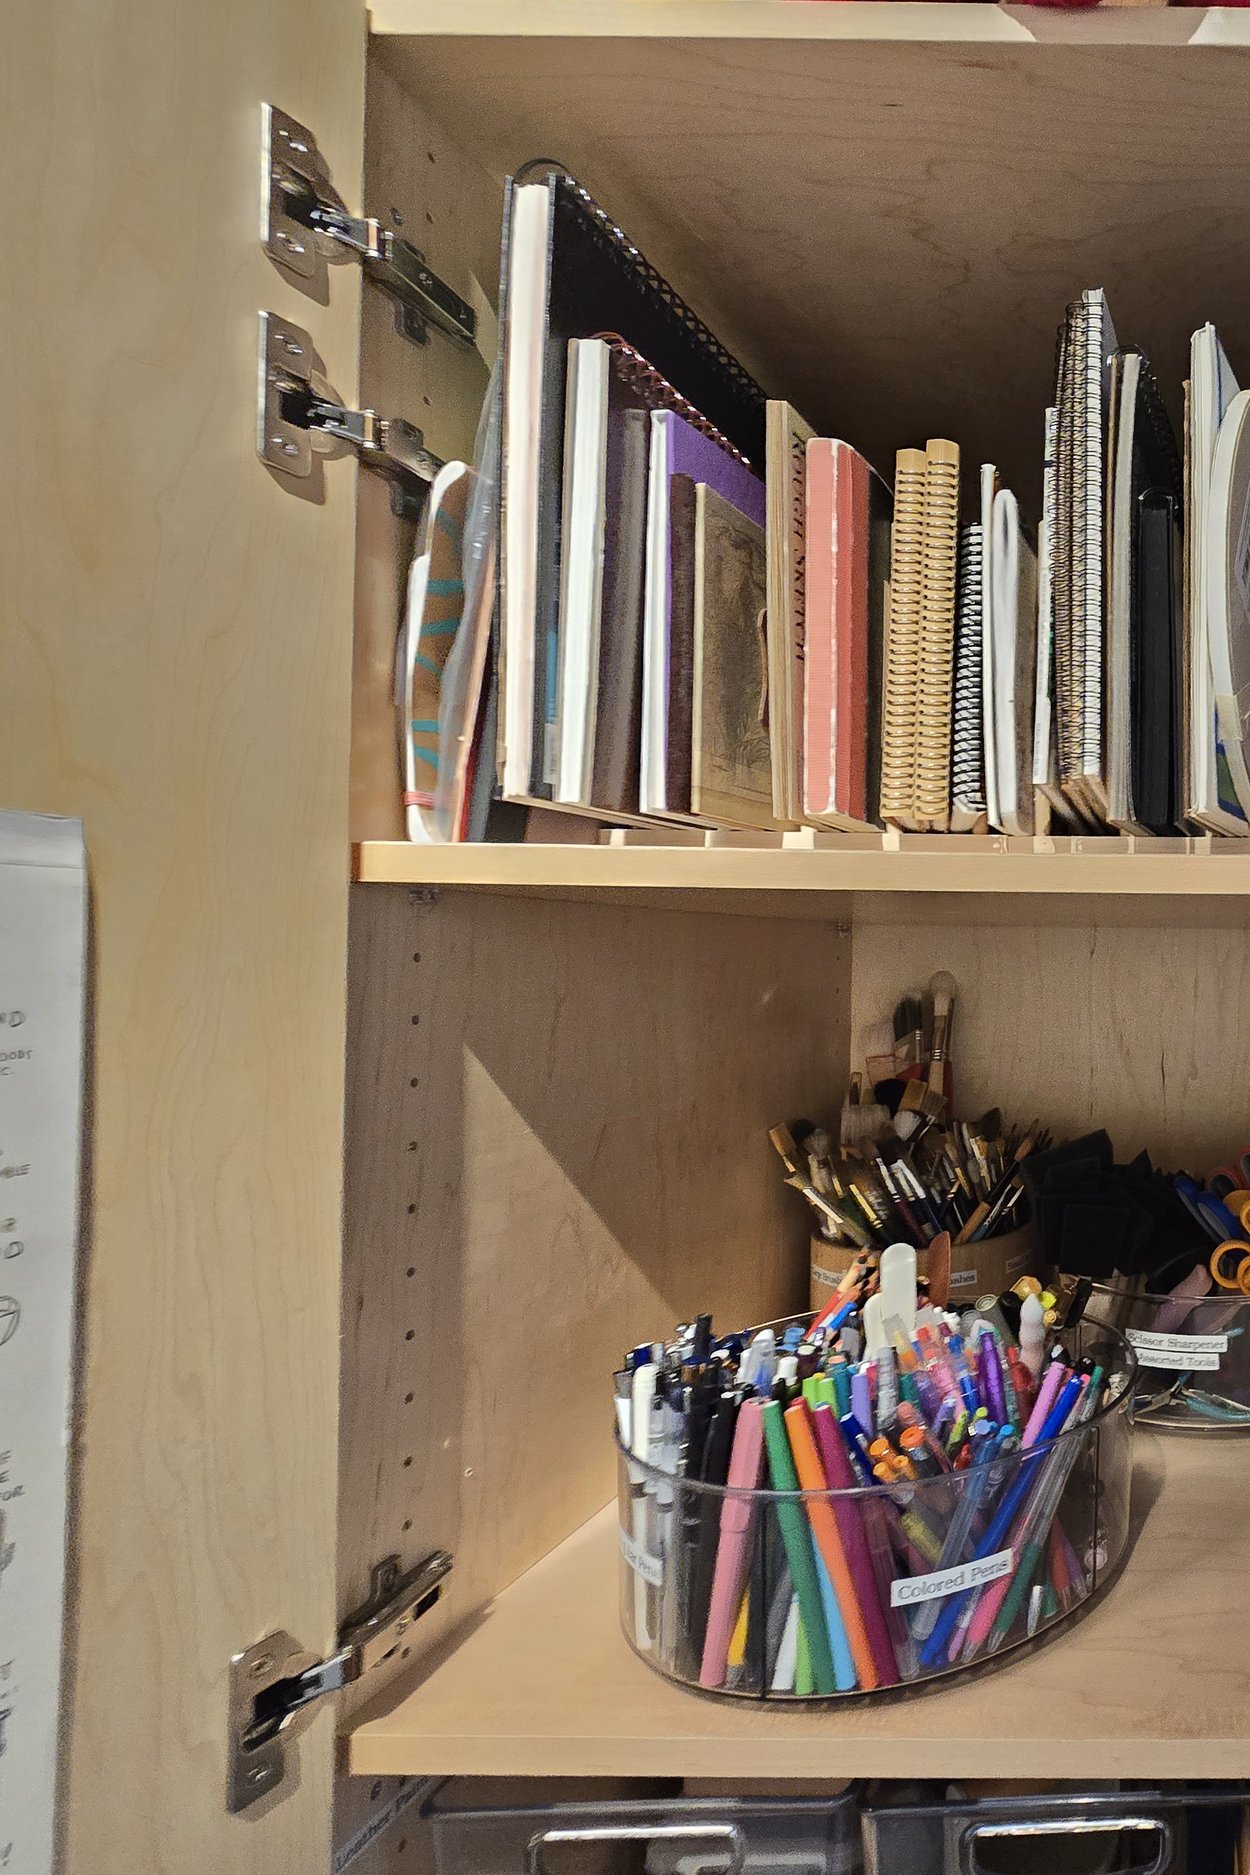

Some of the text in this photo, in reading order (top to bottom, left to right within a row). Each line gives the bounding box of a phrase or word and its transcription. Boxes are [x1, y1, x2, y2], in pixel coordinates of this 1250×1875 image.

[1127, 1332, 1224, 1351] Scissor Sharpener
[897, 1559, 1008, 1600] Colored Pens
